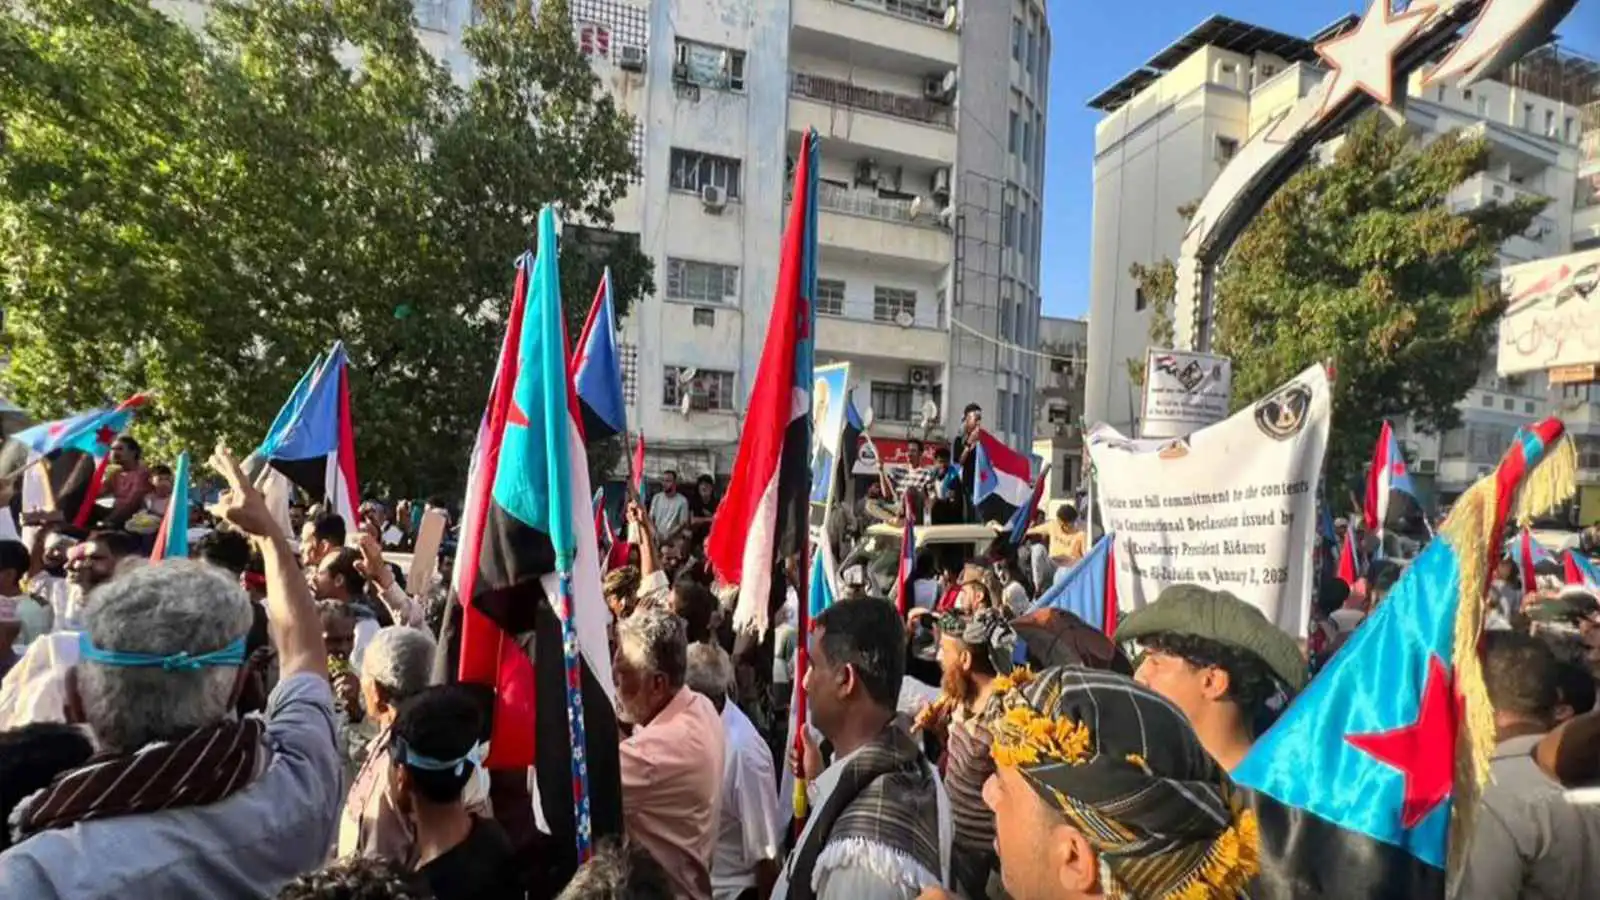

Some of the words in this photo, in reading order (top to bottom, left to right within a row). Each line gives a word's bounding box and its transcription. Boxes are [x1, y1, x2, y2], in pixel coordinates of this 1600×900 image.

[1162, 488, 1229, 508] commitment
[1233, 488, 1243, 502] to
[1260, 480, 1309, 497] contents
[1124, 517, 1185, 532] Constitutional
[1187, 514, 1239, 532] Declaration
[1241, 509, 1275, 527] issued
[1281, 508, 1295, 530] by
[1181, 541, 1220, 556] President
